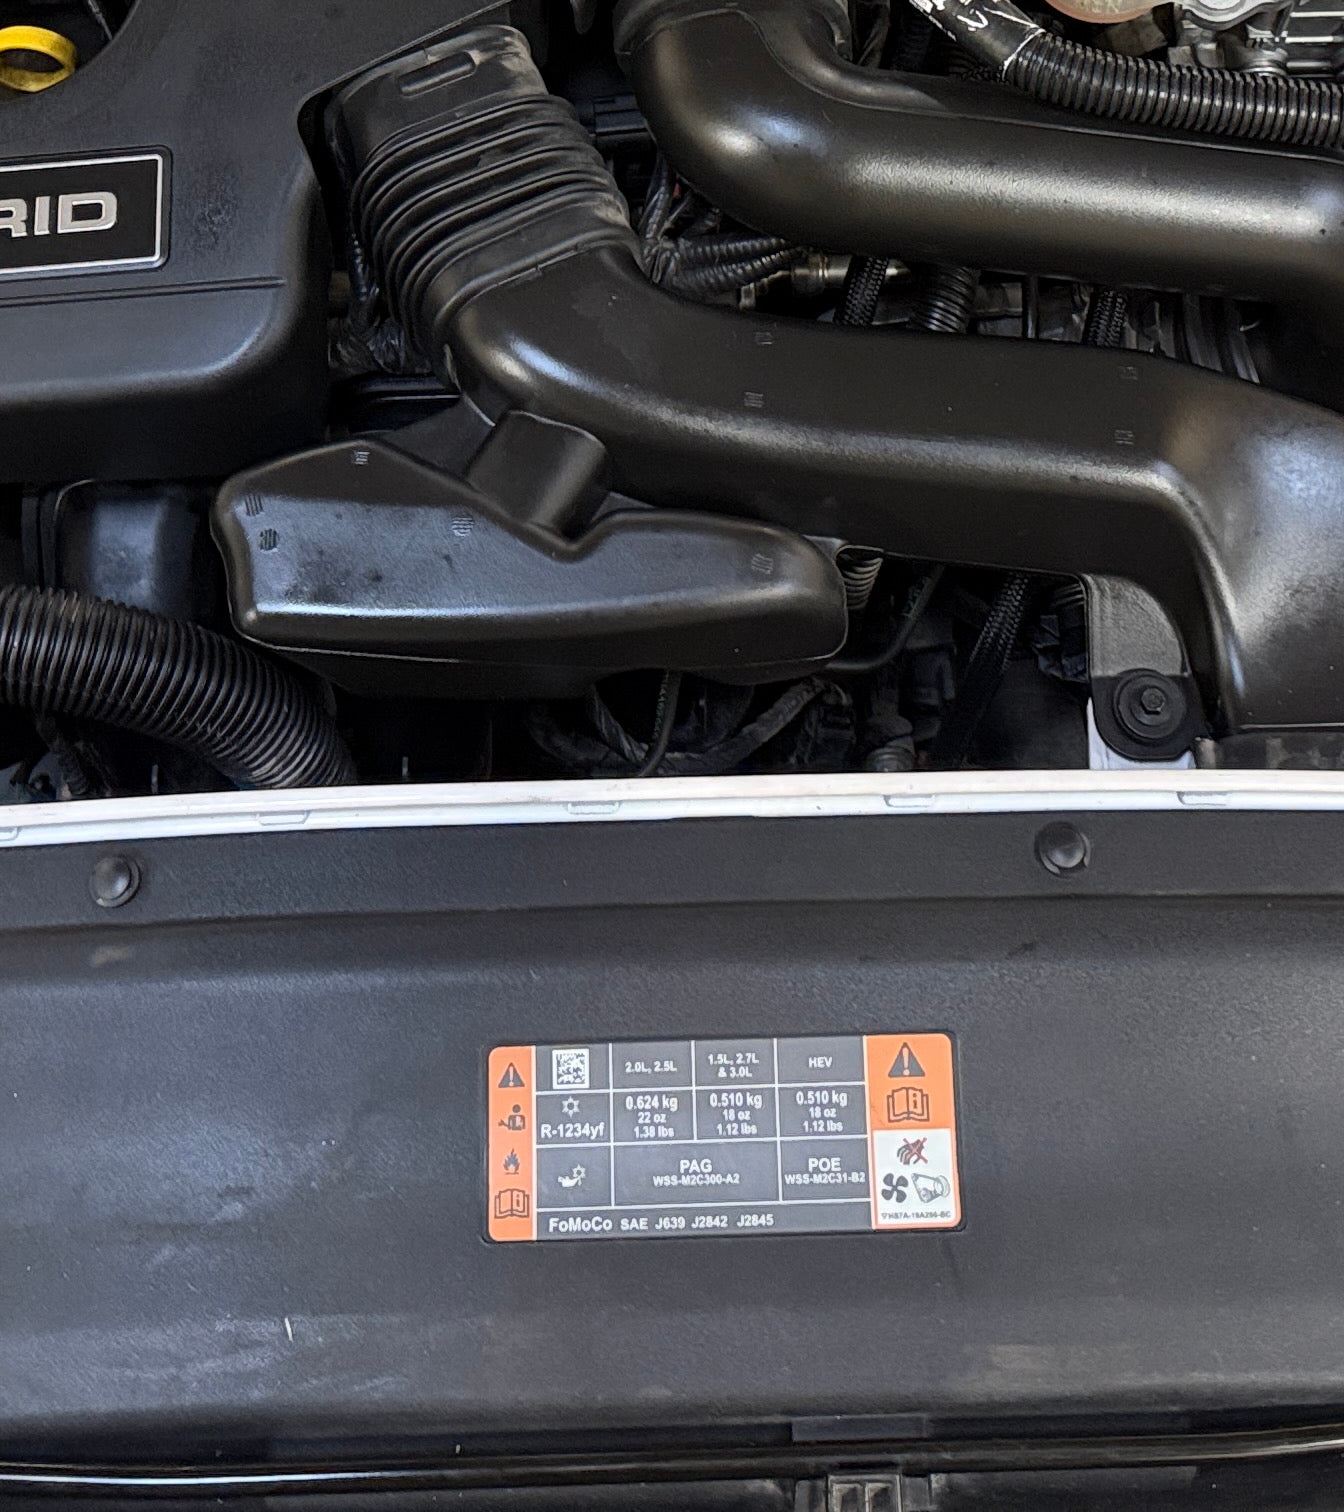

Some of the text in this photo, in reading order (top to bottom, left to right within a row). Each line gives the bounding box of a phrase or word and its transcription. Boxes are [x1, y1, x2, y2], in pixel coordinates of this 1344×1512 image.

[736, 1052, 760, 1065] 2.7L
[808, 1056, 833, 1069] HEV
[625, 1059, 678, 1074] 2.0L, 2.5L
[729, 1066, 752, 1078] 3.0L
[626, 1093, 679, 1112] 0.624 kg
[710, 1092, 763, 1111] 0.510 kg
[796, 1091, 848, 1109] 0.510 kg
[637, 1112, 667, 1124] 22 oz
[723, 1110, 751, 1122] 18 oz
[810, 1107, 837, 1119] 18 oz
[540, 1122, 605, 1141] R-1234yf
[656, 1124, 675, 1138] lbs
[717, 1122, 758, 1136] 1.12 lbs
[803, 1120, 844, 1134] 1.12 lbs
[679, 1158, 713, 1174] PAG
[808, 1156, 842, 1172] POE
[548, 1213, 775, 1234] FoMoCo SAE J639 J2842 J2845
